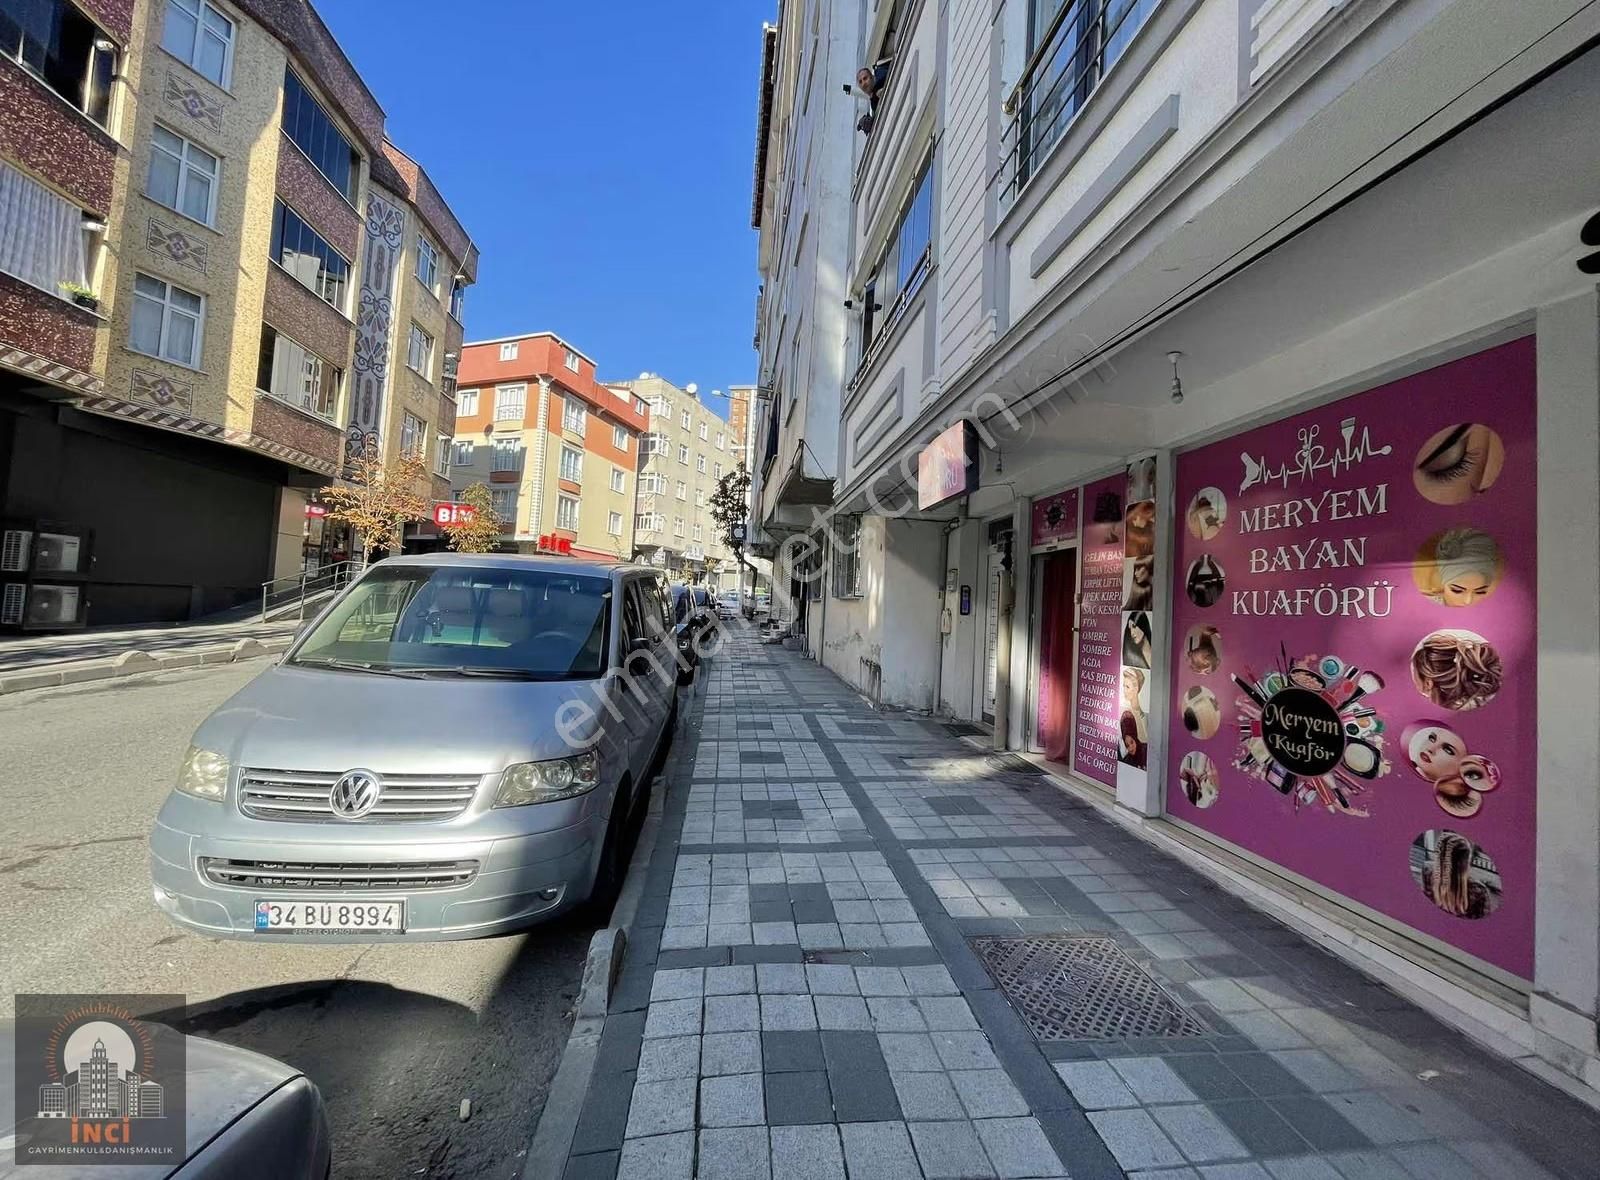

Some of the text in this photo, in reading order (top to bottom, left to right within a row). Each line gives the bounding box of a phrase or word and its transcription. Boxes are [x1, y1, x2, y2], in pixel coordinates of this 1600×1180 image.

[1239, 483, 1389, 534] MERYEM
[1249, 537, 1368, 574] BAYAN
[1232, 580, 1395, 618] KUAFÖRÜ
[1264, 703, 1340, 740] Meryem
[1268, 733, 1335, 763] Kuaför
[269, 905, 297, 926] 34
[305, 905, 332, 926] BU
[338, 905, 393, 926] 8994
